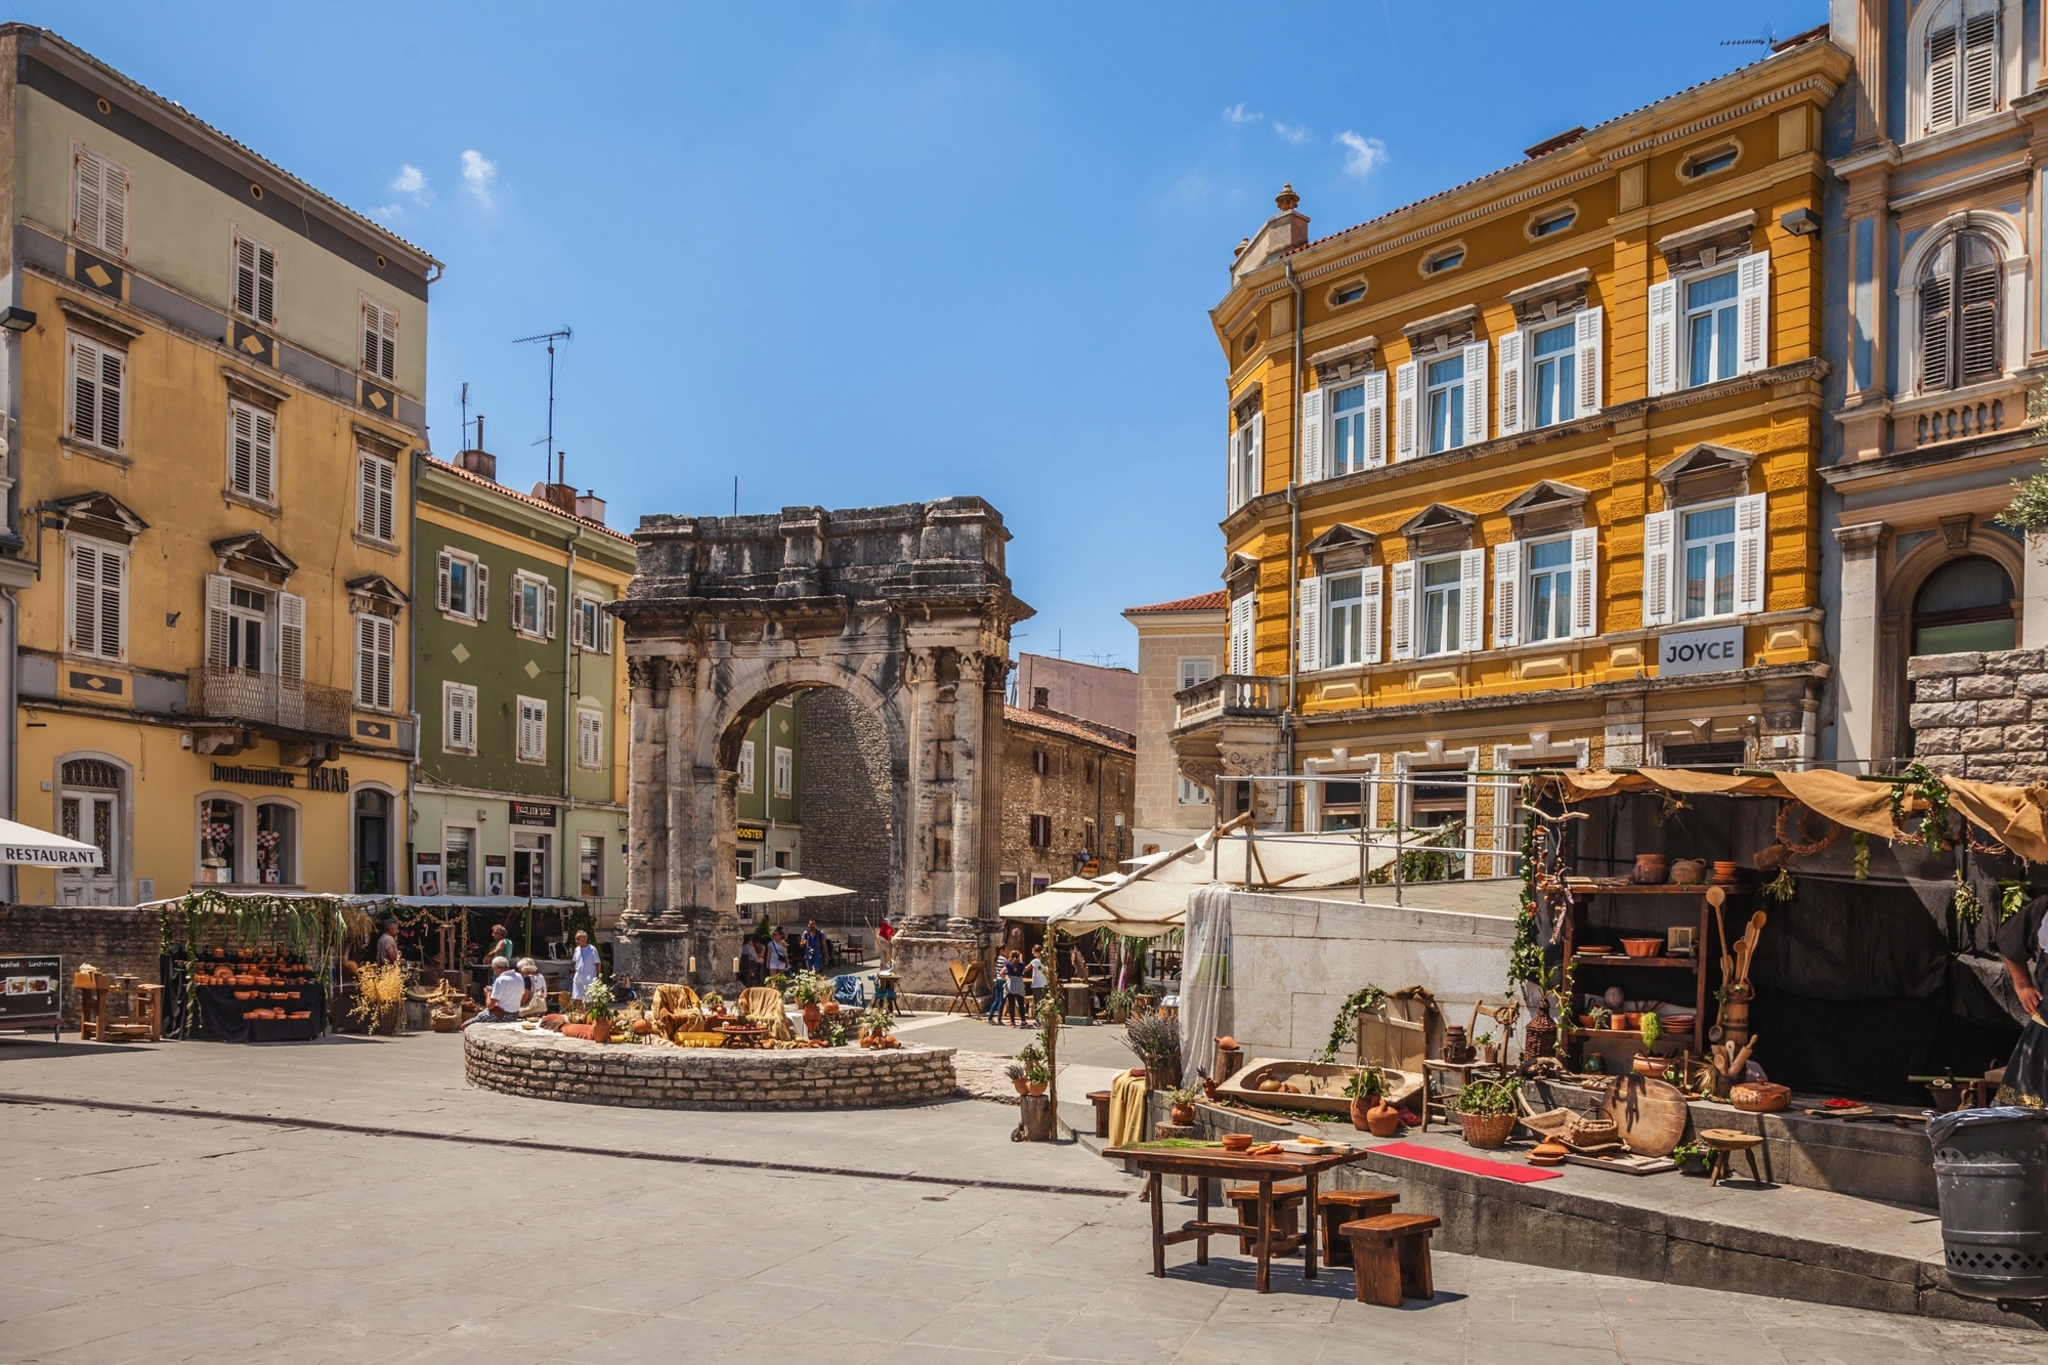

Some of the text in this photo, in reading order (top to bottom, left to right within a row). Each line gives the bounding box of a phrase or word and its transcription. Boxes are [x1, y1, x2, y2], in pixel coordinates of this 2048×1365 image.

[1666, 640, 1735, 664] JOYCE
[307, 766, 350, 794] KRAŠ
[5, 847, 96, 864] RESTAURANT
